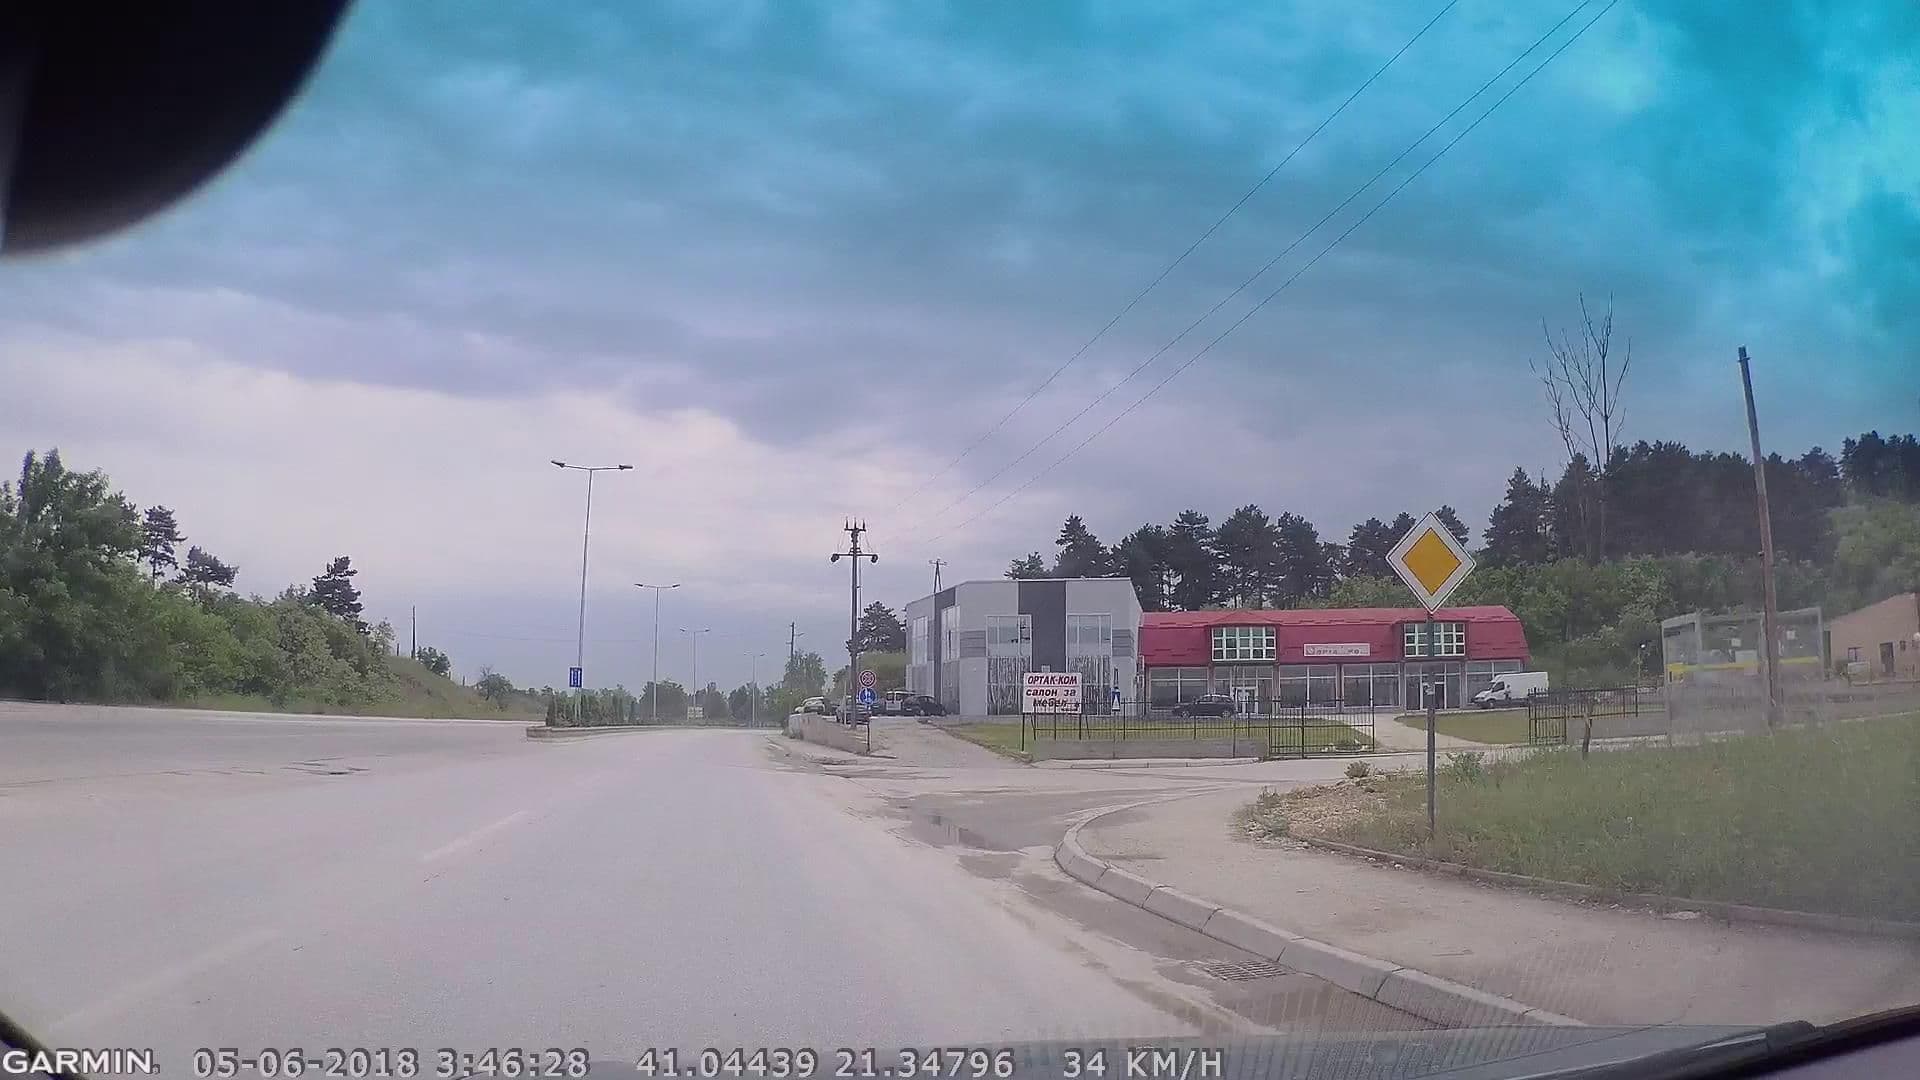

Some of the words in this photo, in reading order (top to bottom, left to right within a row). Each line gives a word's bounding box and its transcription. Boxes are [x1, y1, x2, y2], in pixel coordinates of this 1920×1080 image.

[1028, 676, 1077, 685] ОРТАК-КОМ
[1026, 689, 1058, 697] салон
[1063, 689, 1076, 697] за
